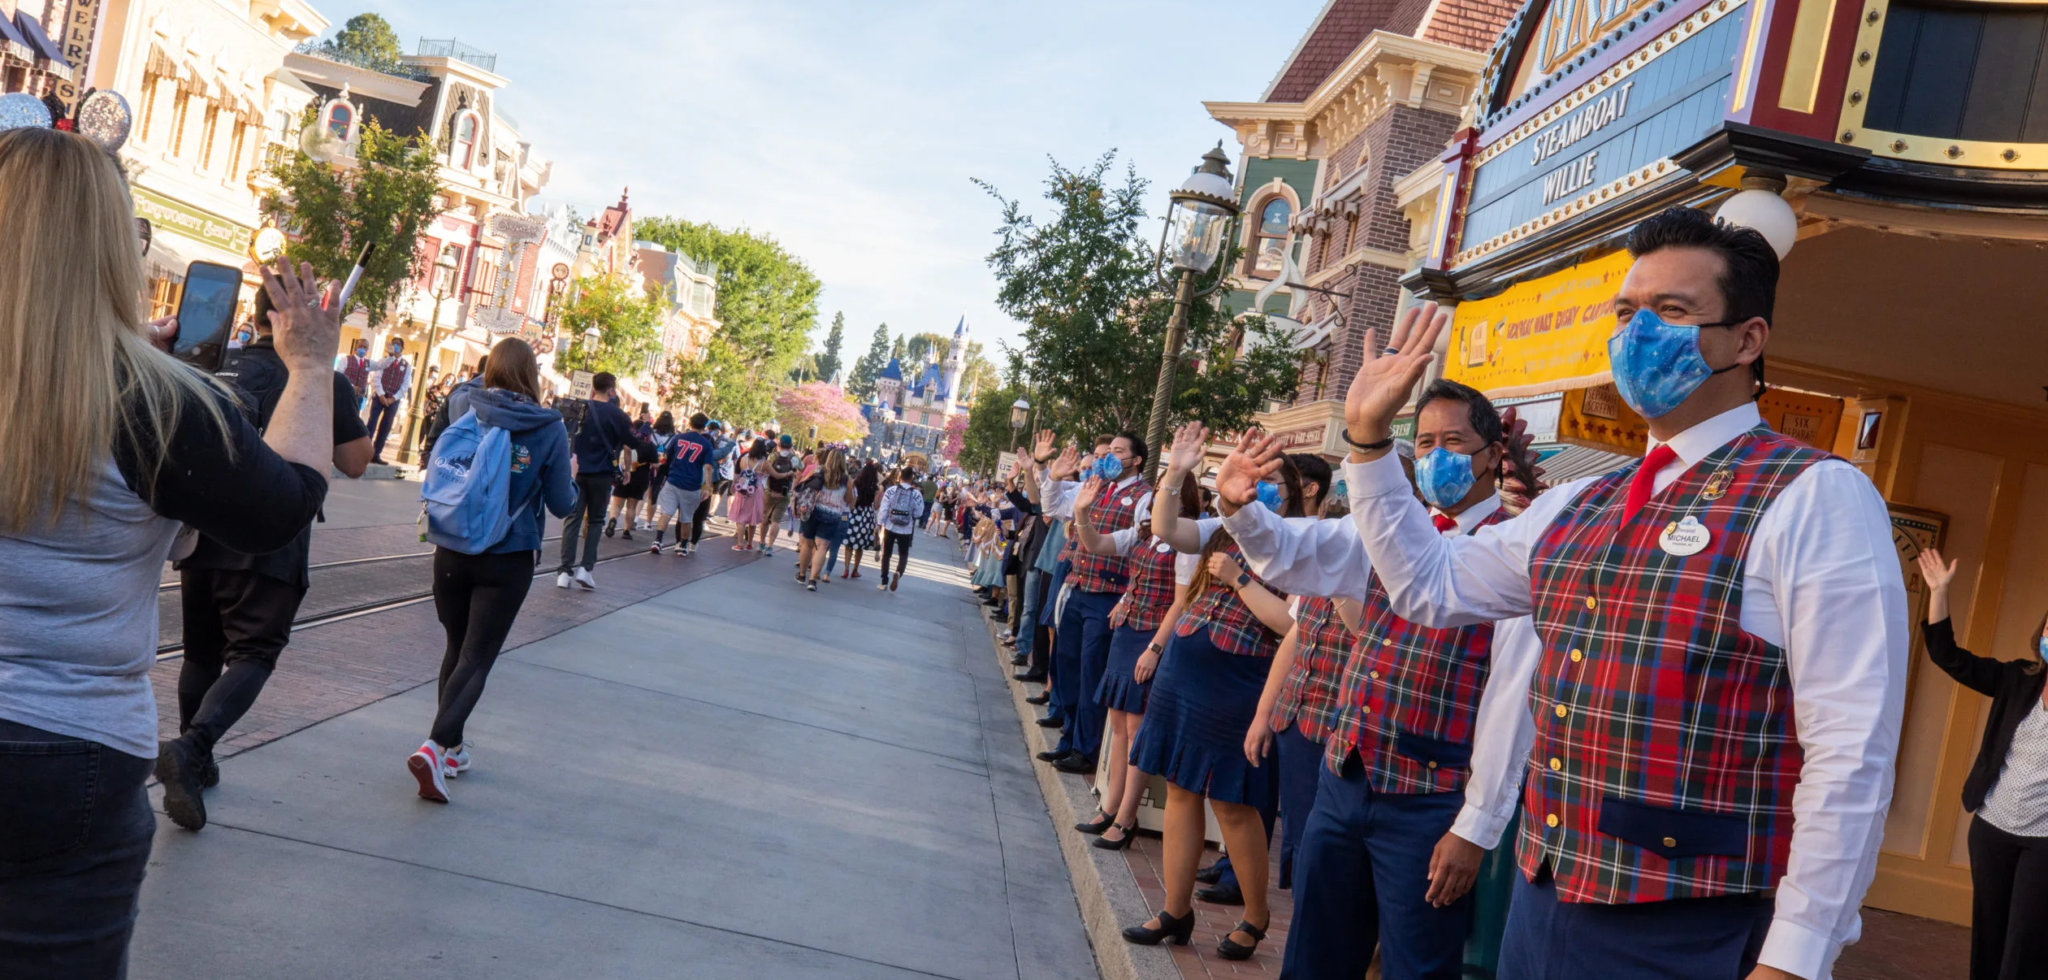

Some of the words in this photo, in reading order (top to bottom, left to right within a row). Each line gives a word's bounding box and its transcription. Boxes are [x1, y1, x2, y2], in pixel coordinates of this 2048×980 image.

[1531, 81, 1634, 166] STEAMBOAT
[1543, 151, 1598, 206] WILLIE
[1534, 312, 1554, 334] WALT
[1586, 400, 1615, 417] SCREENS
[1795, 417, 1810, 428] SIX
[677, 439, 703, 462] 77
[1667, 534, 1700, 543] MICHAEL
